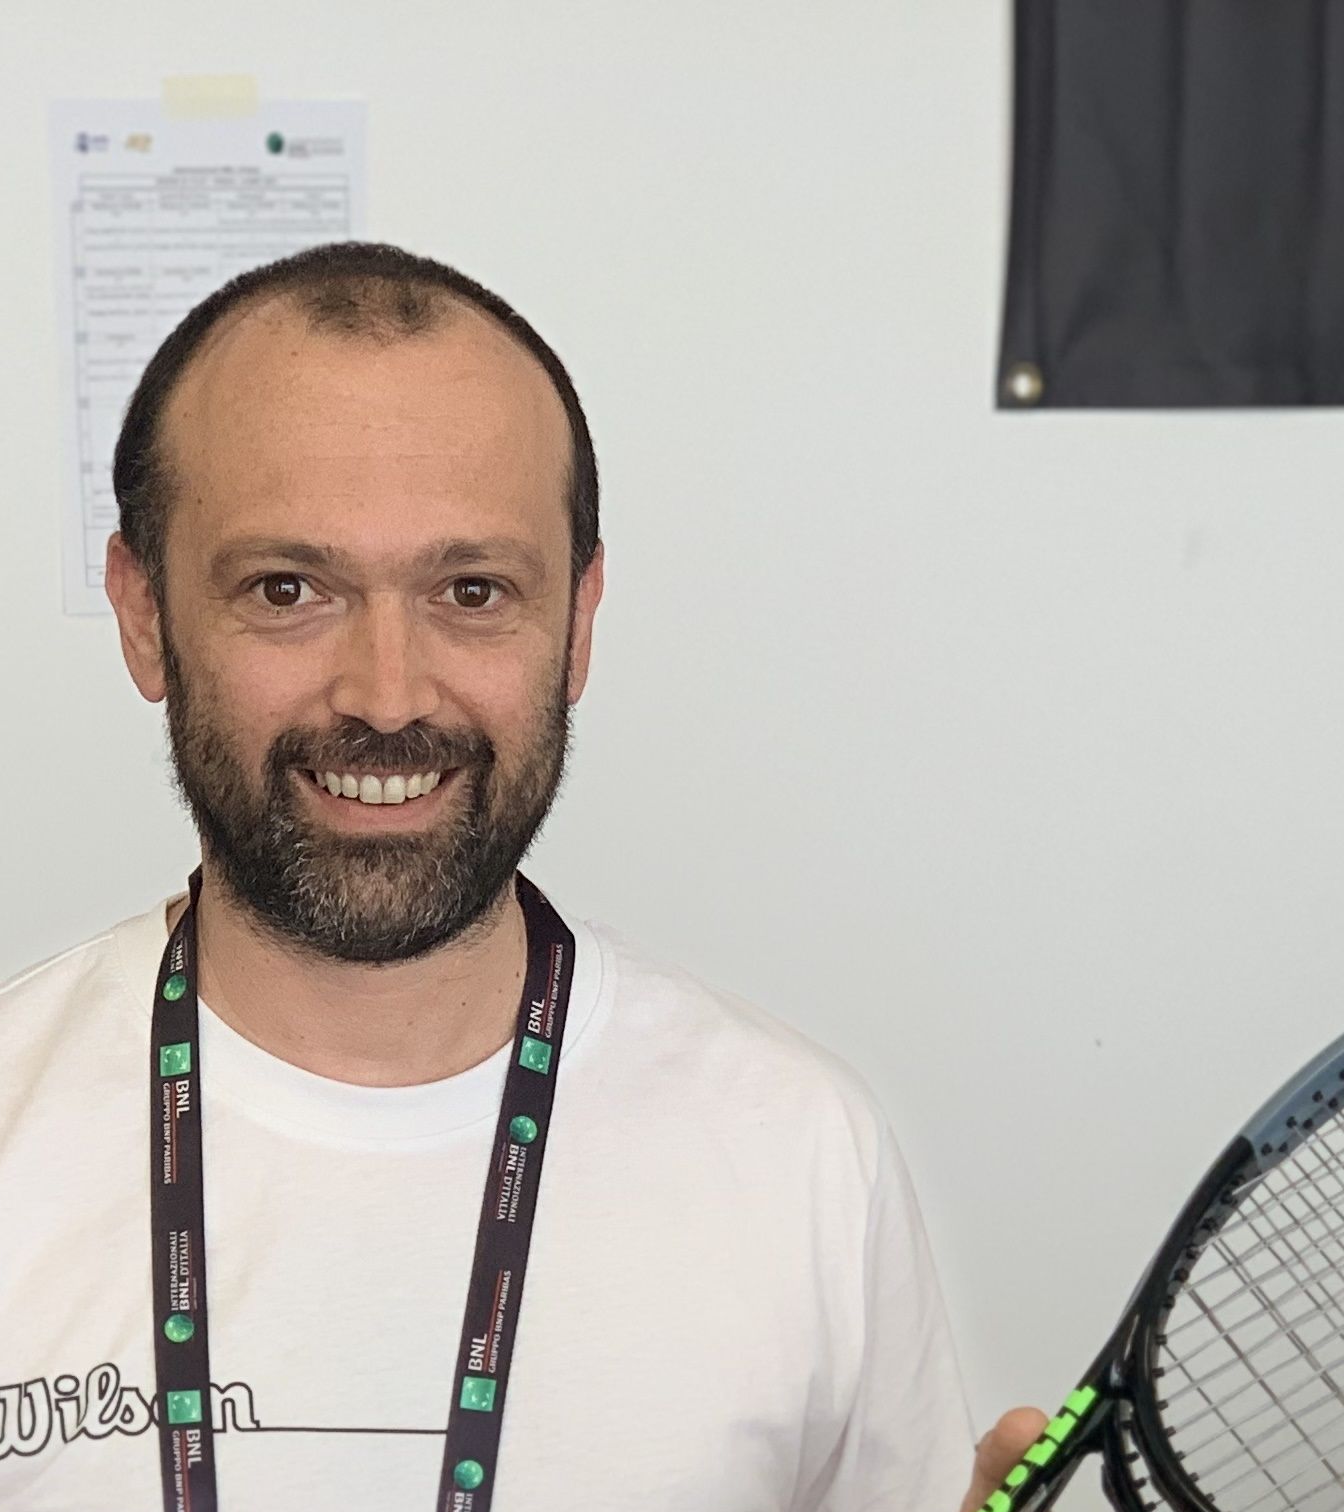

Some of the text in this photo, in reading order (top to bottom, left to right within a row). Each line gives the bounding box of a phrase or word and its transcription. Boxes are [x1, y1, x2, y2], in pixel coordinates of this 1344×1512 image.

[528, 999, 545, 1034] BNL
[163, 1082, 171, 1121] GRUPPO
[176, 1080, 190, 1119] BNL
[164, 1145, 172, 1184] PARIBAS
[505, 1144, 519, 1172] BNL
[508, 1146, 527, 1222] INTERNAZIONALI
[169, 1231, 179, 1311] INTERNAZIONALI
[179, 1278, 190, 1310] BNL
[488, 1334, 501, 1373] GRUPPO
[498, 1270, 512, 1310] PARIBAS
[468, 1333, 487, 1371] BNL
[172, 1431, 182, 1471] GRUPPO
[186, 1429, 202, 1468] BNL
